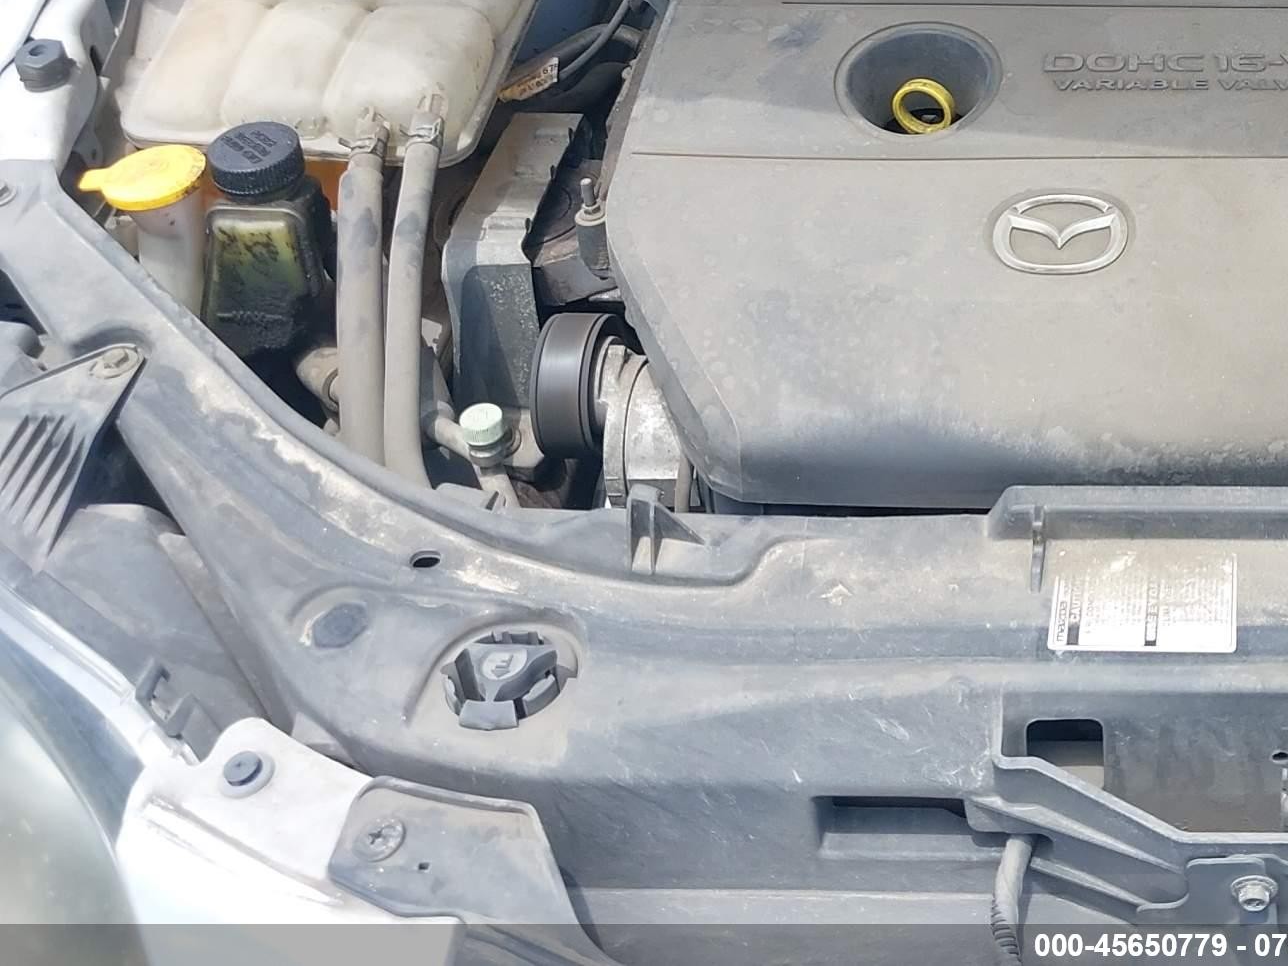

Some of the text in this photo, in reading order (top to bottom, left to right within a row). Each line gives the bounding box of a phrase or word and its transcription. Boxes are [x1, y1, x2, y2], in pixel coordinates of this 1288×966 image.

[1043, 52, 1205, 73] DOHC
[1054, 78, 1210, 92] VARIABLE
[1056, 600, 1068, 642] mazda
